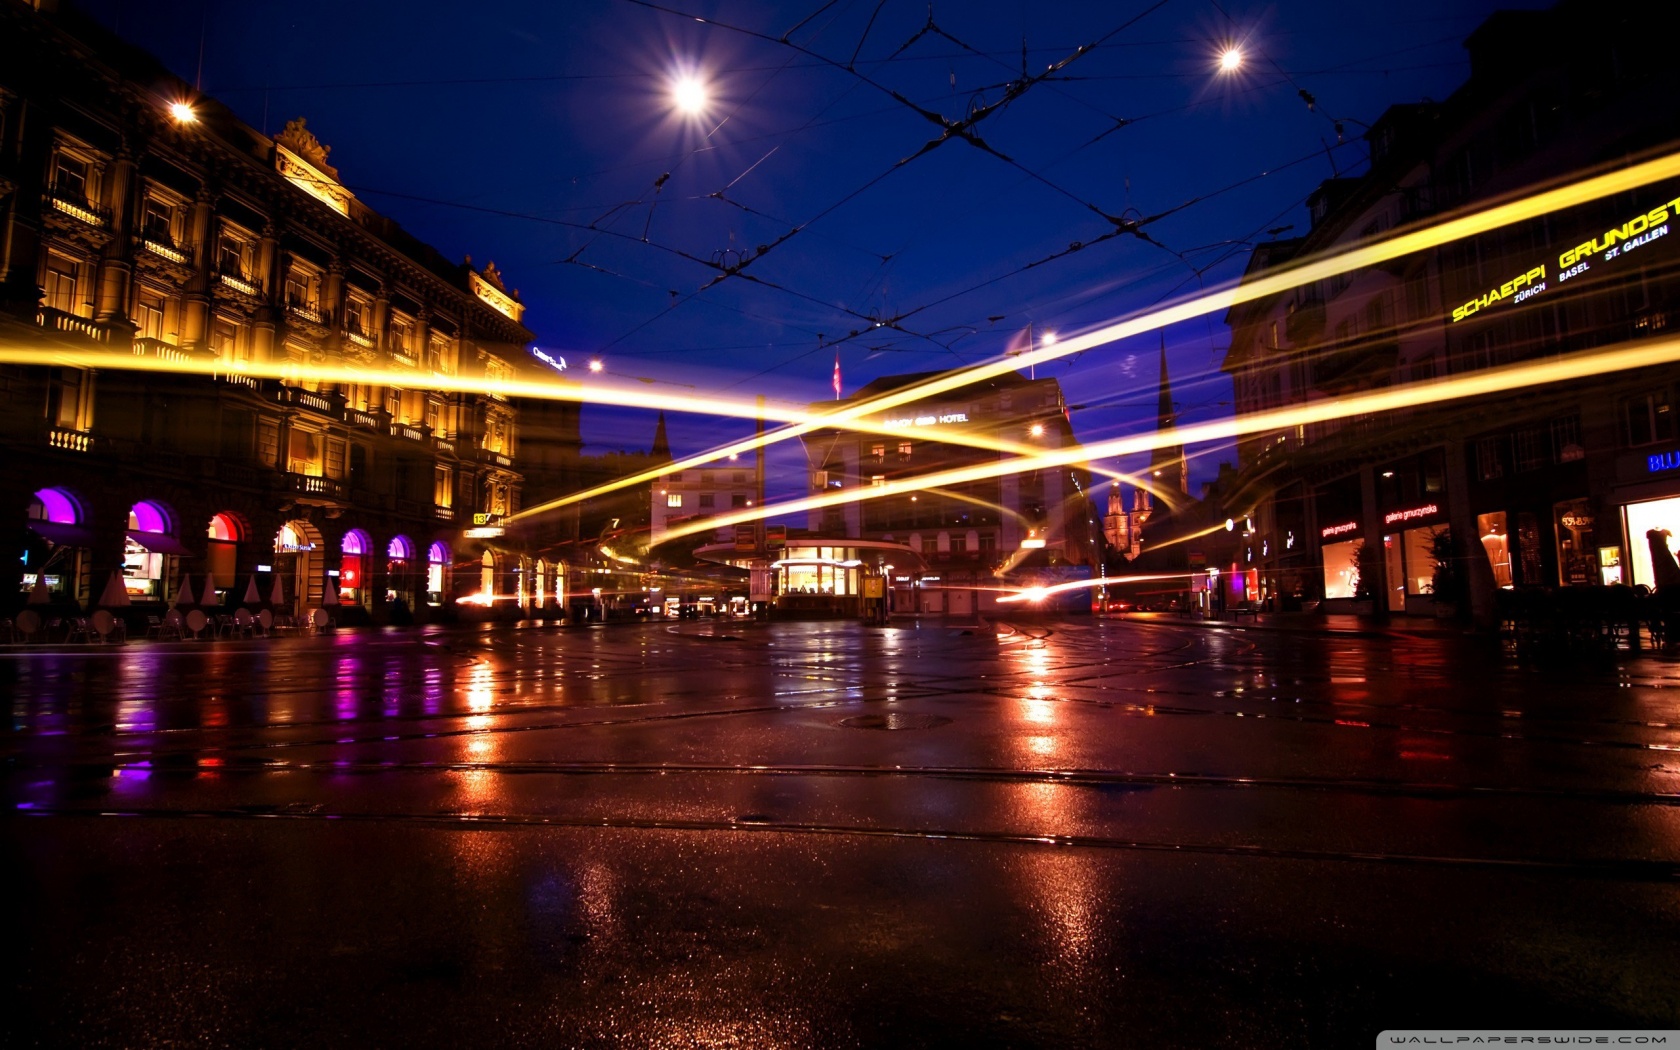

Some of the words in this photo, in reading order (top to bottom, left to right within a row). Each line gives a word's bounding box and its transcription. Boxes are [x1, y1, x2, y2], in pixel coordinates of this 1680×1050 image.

[1452, 264, 1546, 322] SCHAEPPI
[1558, 196, 1680, 269] GRUNDST
[1513, 282, 1546, 304] ZÜRICH
[1559, 261, 1590, 282] BASEL
[1604, 249, 1621, 262] ST.
[1623, 224, 1668, 253] GALLEN
[939, 413, 969, 424] HOTEL
[475, 515, 485, 523] 13
[611, 518, 620, 529] 7
